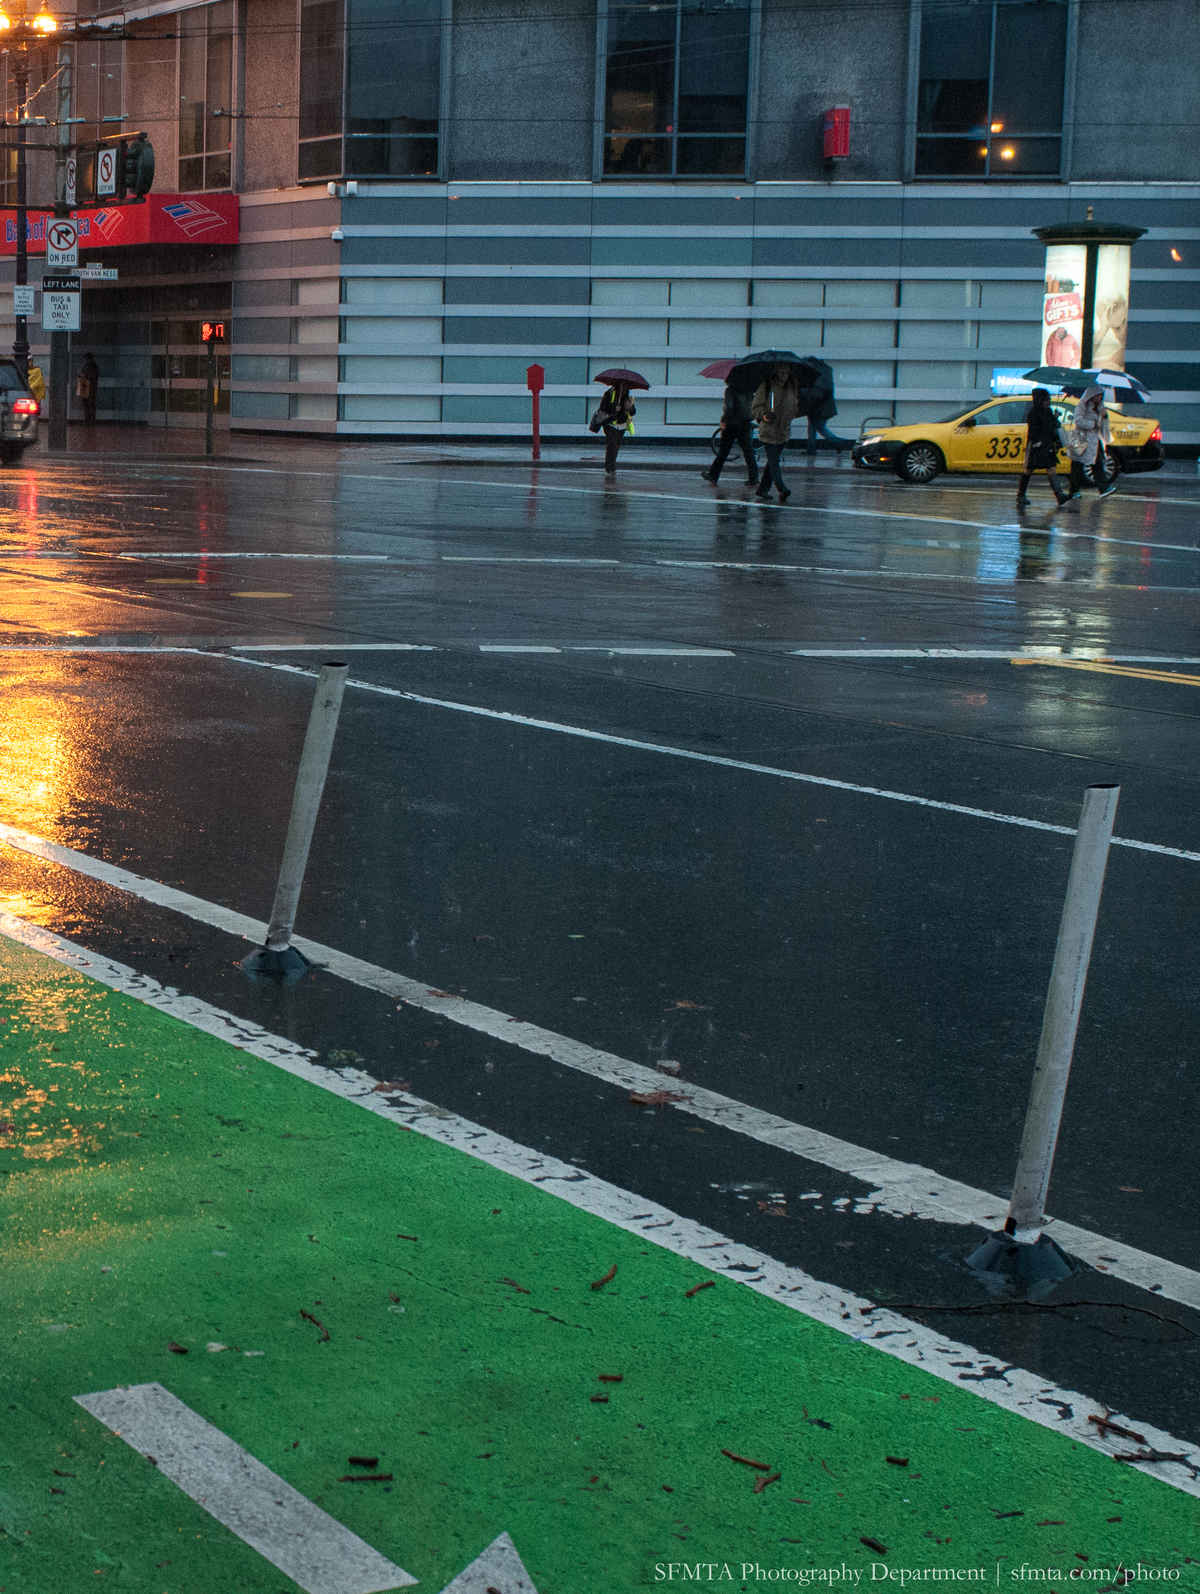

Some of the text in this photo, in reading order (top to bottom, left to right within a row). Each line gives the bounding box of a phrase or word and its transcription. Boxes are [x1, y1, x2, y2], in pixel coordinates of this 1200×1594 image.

[6, 216, 32, 242] Bak
[33, 215, 44, 241] of
[49, 254, 76, 262] ON RED
[61, 281, 80, 289] LANE
[1046, 304, 1080, 322] GIFTS
